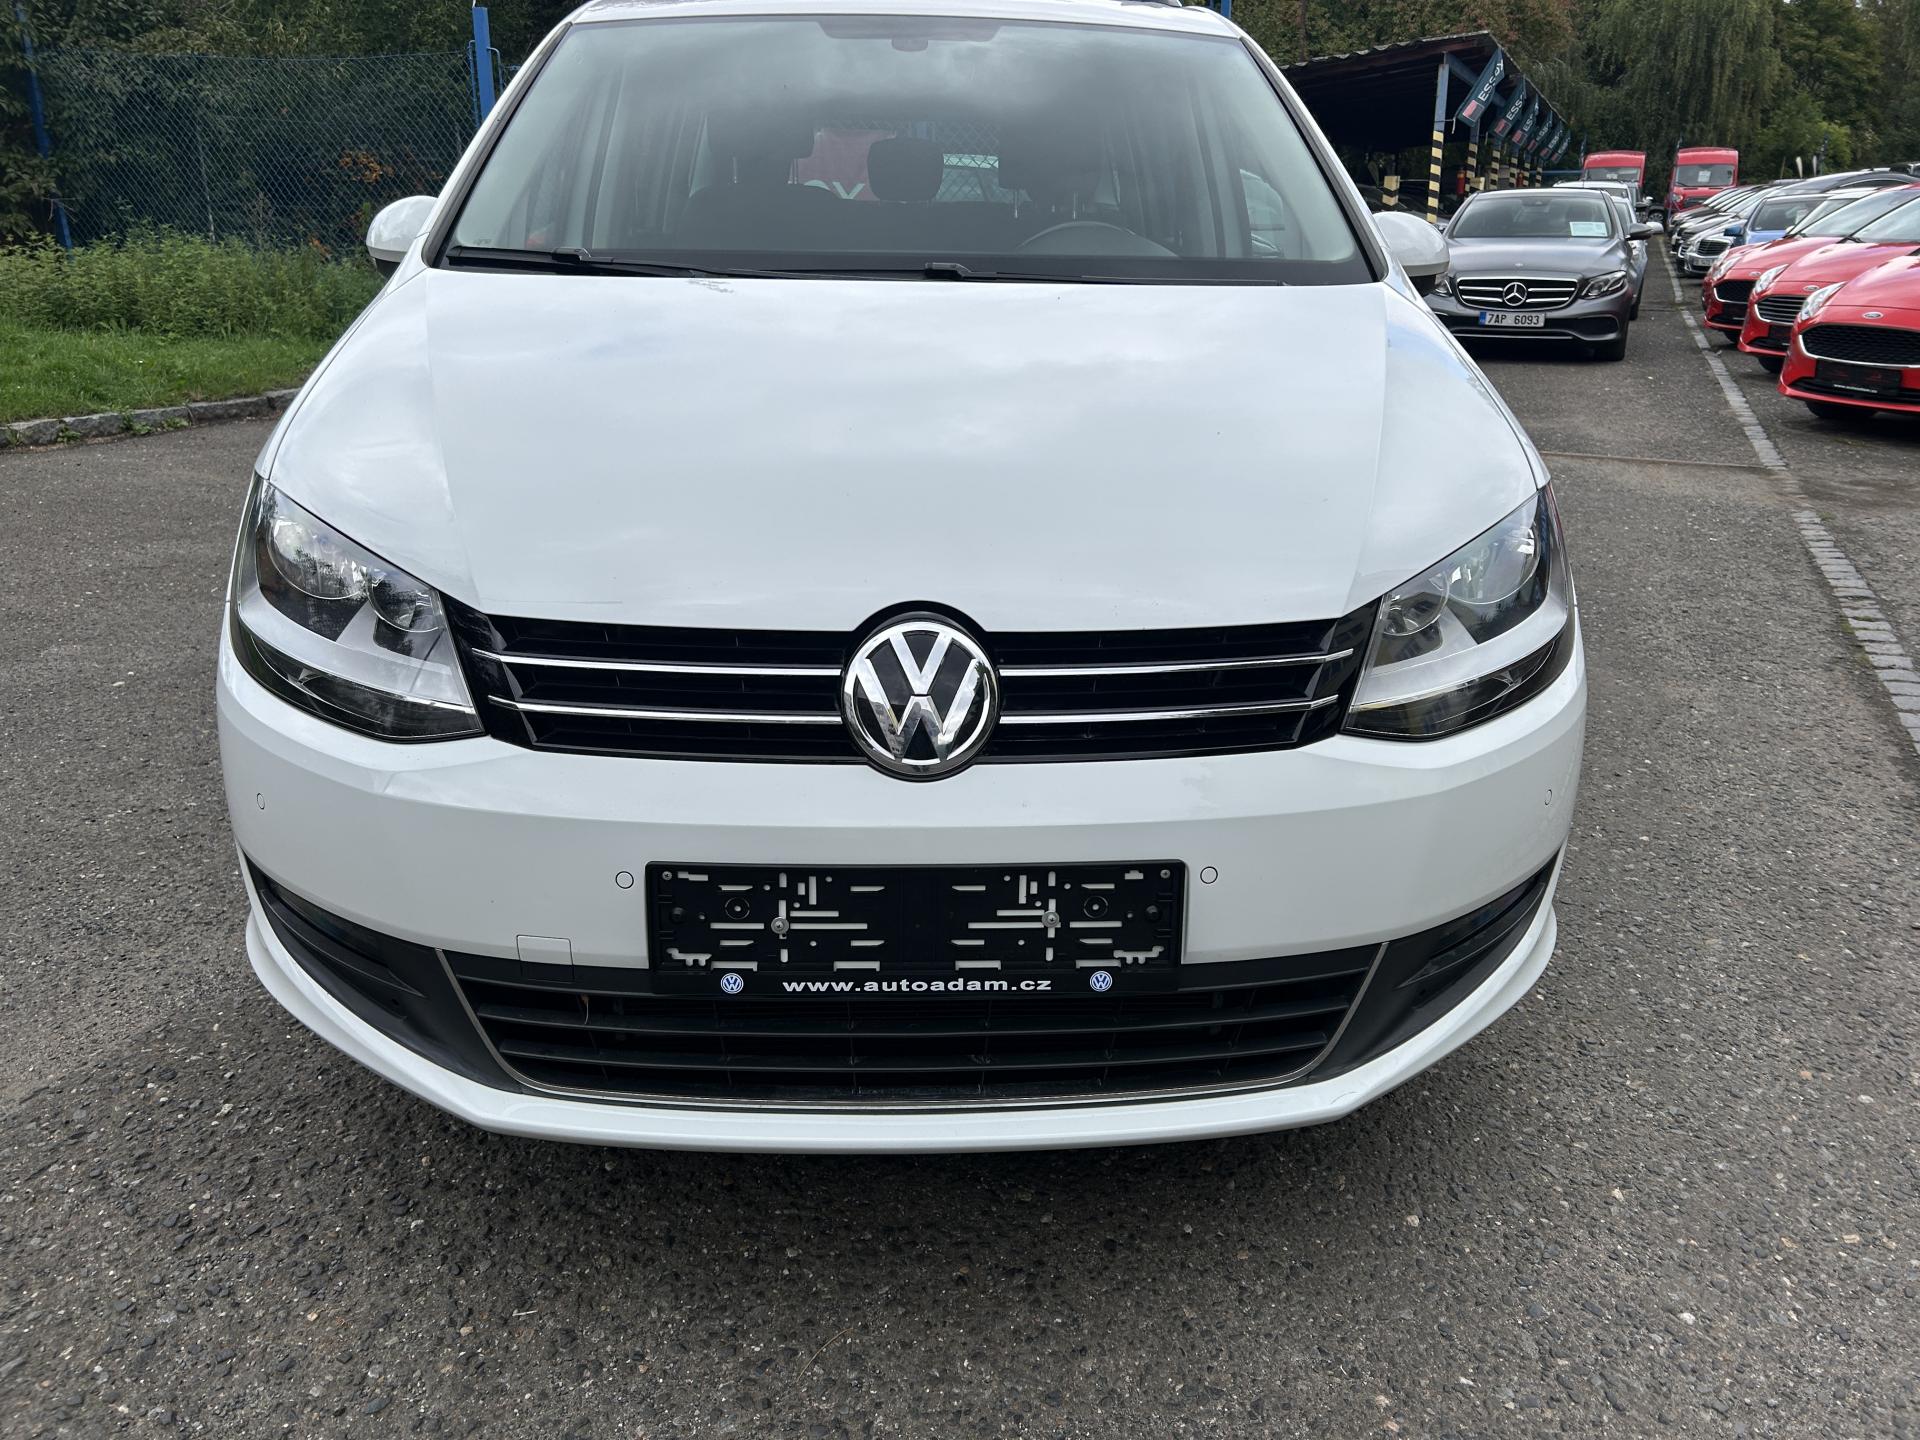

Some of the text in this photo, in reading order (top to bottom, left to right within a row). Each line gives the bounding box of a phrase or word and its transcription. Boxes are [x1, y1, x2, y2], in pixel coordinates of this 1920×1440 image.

[1488, 314, 1540, 325] 7AP 6093
[783, 977, 1052, 993] www.autoadam.cz
